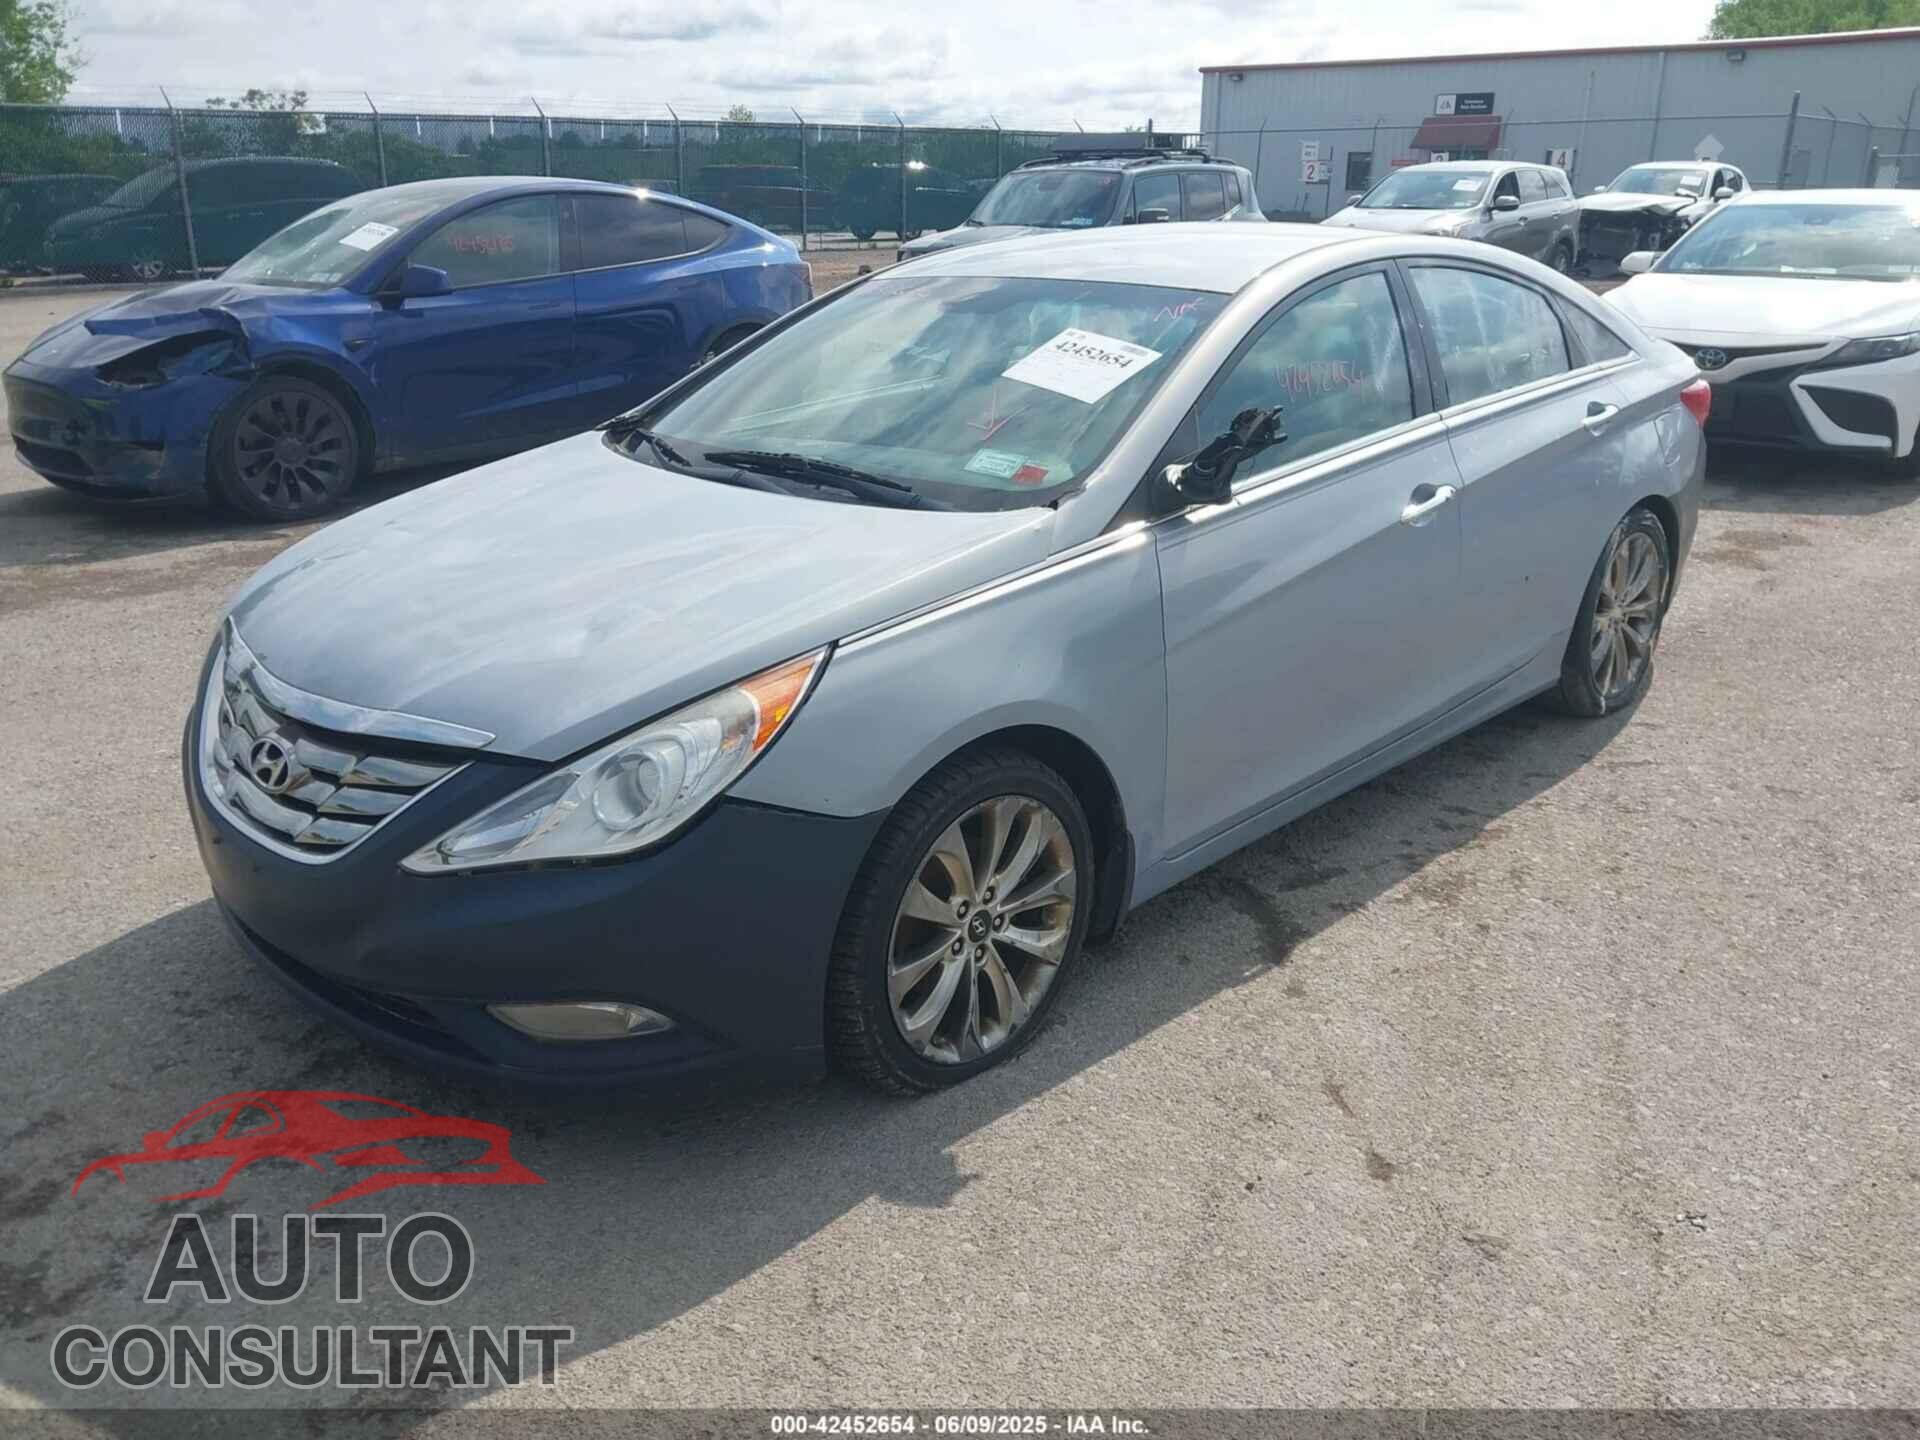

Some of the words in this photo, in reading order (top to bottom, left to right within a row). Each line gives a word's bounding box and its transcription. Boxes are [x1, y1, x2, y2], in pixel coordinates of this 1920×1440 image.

[1556, 151, 1566, 168] 4
[1306, 164, 1314, 180] 2
[1056, 341, 1134, 368] 42452654
